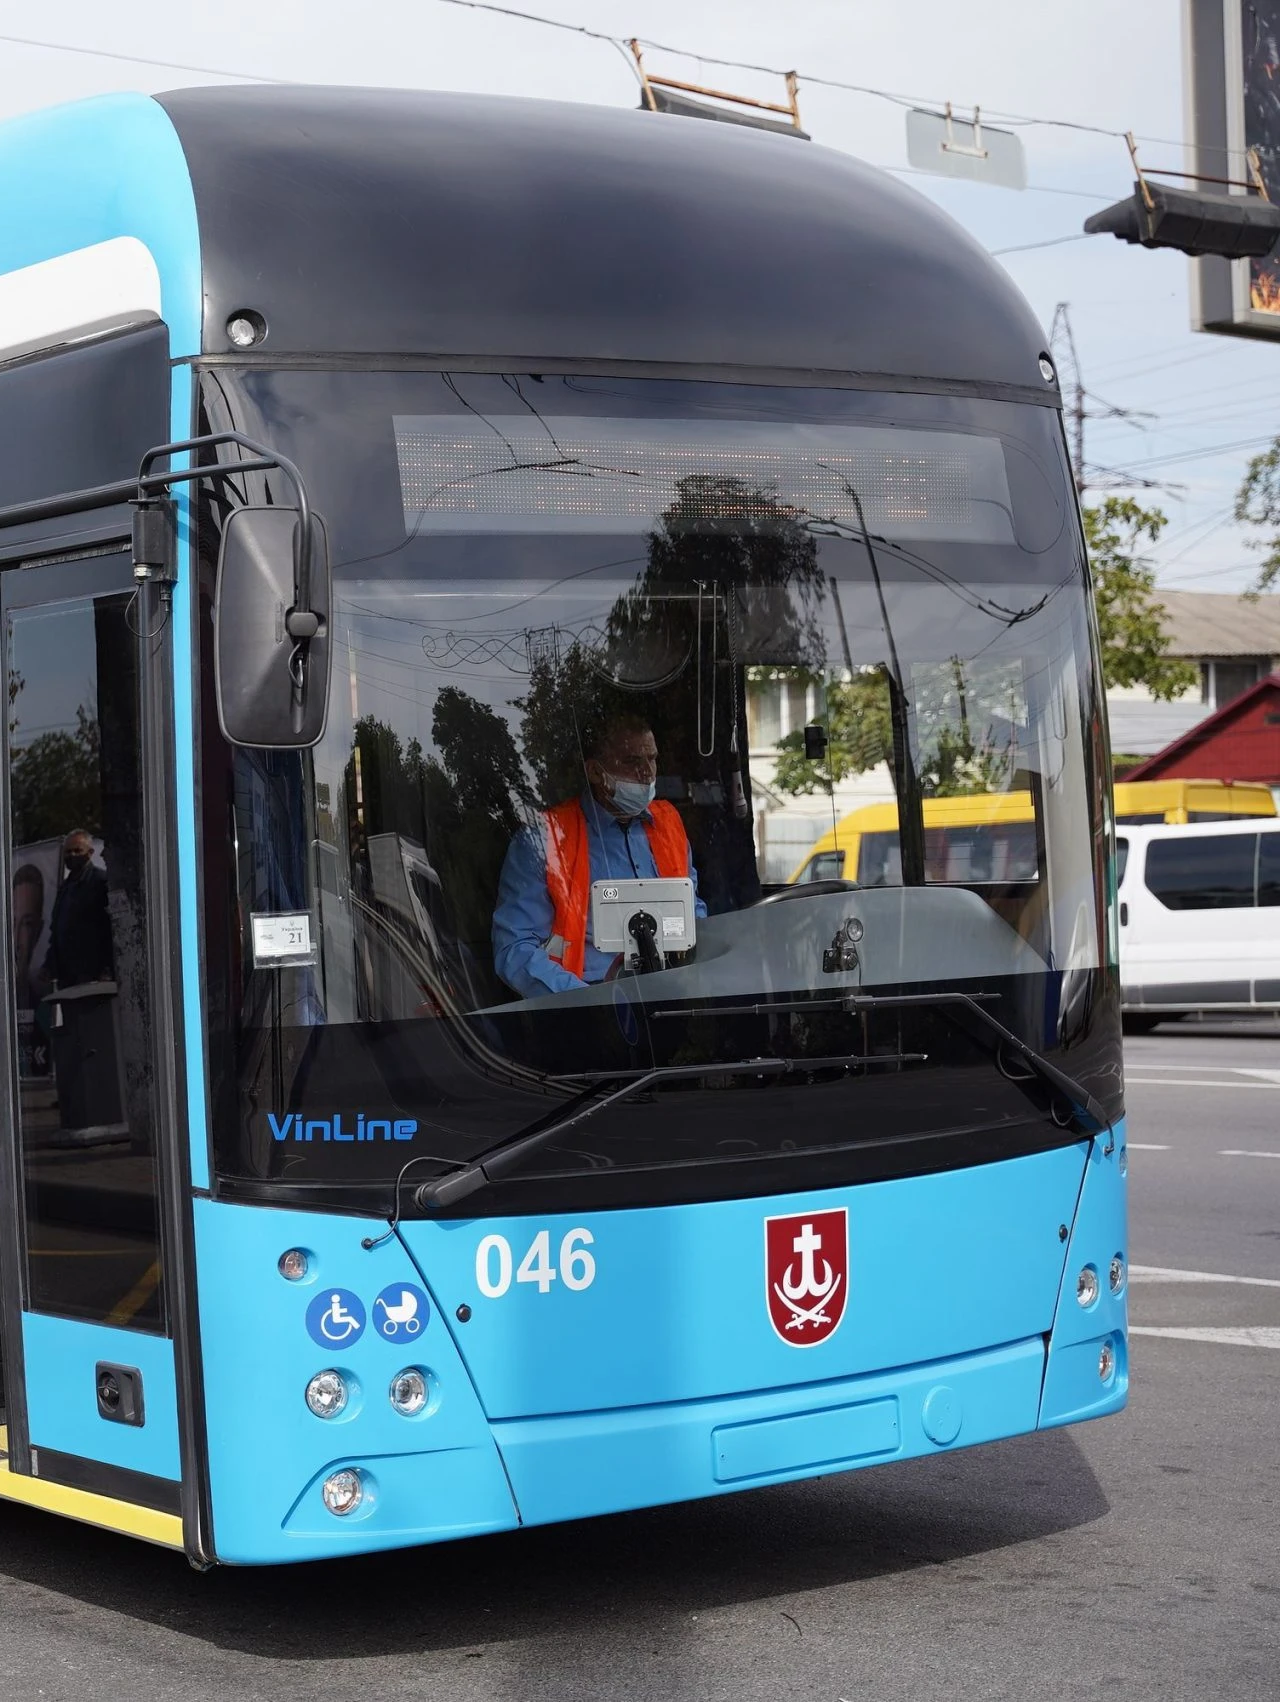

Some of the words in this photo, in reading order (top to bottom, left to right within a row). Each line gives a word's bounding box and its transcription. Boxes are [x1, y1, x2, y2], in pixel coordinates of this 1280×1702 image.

[289, 933, 302, 943] 21
[267, 1113, 418, 1141] VinLine
[475, 1227, 596, 1299] 046
